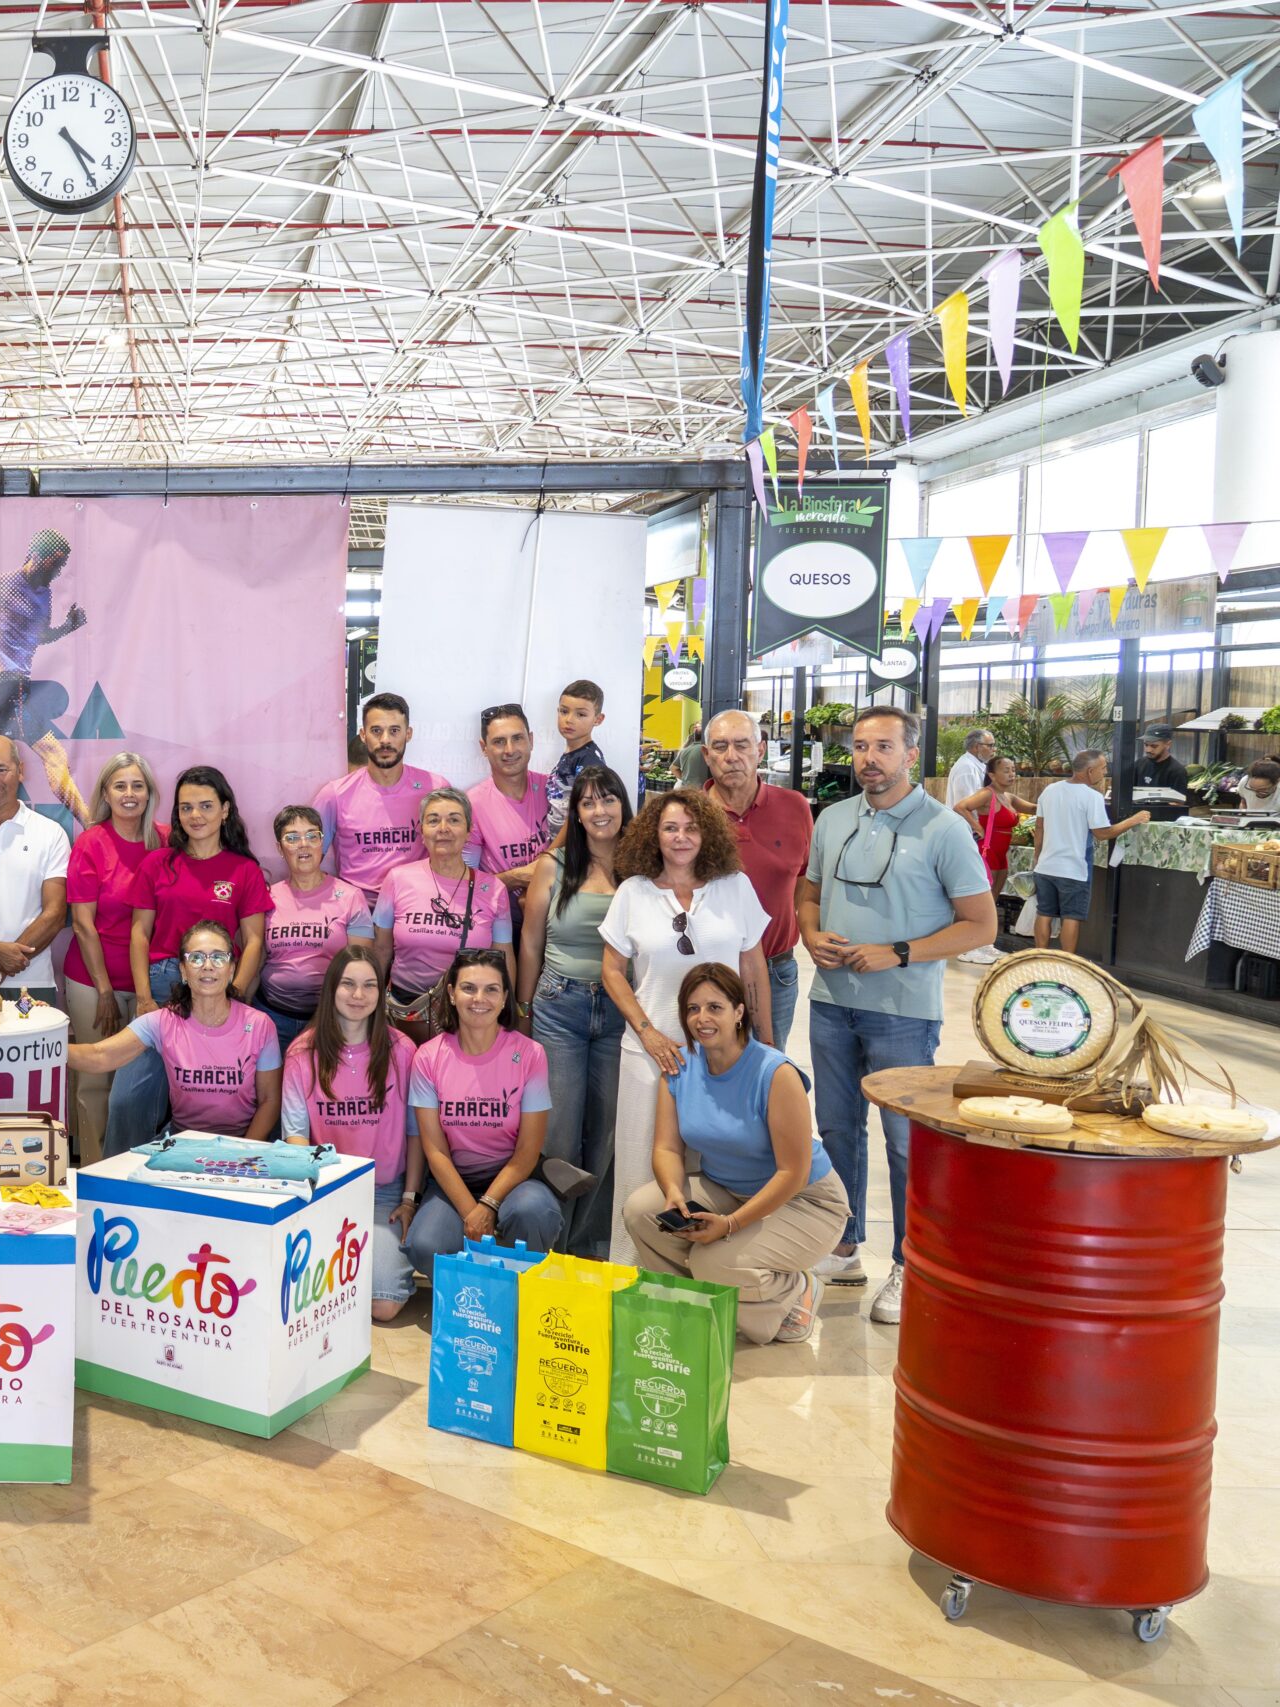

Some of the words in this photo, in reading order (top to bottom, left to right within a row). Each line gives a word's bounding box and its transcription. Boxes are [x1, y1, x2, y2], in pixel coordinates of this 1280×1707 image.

[42, 94, 56, 110] 11
[62, 86, 80, 102] 12
[90, 92, 96, 108] 1
[25, 111, 44, 127] 10
[104, 108, 116, 124] 2
[17, 133, 29, 148] 9
[111, 132, 122, 147] 3
[24, 155, 36, 171] 8
[101, 154, 113, 170] 4
[40, 171, 53, 187] 7
[63, 178, 74, 193] 6
[802, 495, 856, 513] Biosfera
[795, 503, 850, 523] mercado
[789, 573, 851, 585] QUESOS
[1113, 710, 1122, 719] 15
[355, 829, 417, 845] TERACHI
[266, 925, 329, 940] TERACHI
[174, 1066, 243, 1085] TERACHI
[180, 1085, 205, 1093] Casillas
[442, 1119, 468, 1127] Casillas
[87, 1207, 257, 1319] Puerto
[280, 1217, 369, 1326] Puerto
[101, 1299, 134, 1318] DEL
[147, 1308, 233, 1337] ROSARIO
[287, 1316, 308, 1338] DEL
[313, 1285, 358, 1320] ROSARIO
[101, 1314, 233, 1351] FUERTEVENTURA
[287, 1302, 358, 1350] FUERTEVENTURA
[453, 1337, 498, 1354] RECUERDA
[539, 1358, 588, 1375] RECUERDA
[634, 1378, 686, 1396] RECUERDA
